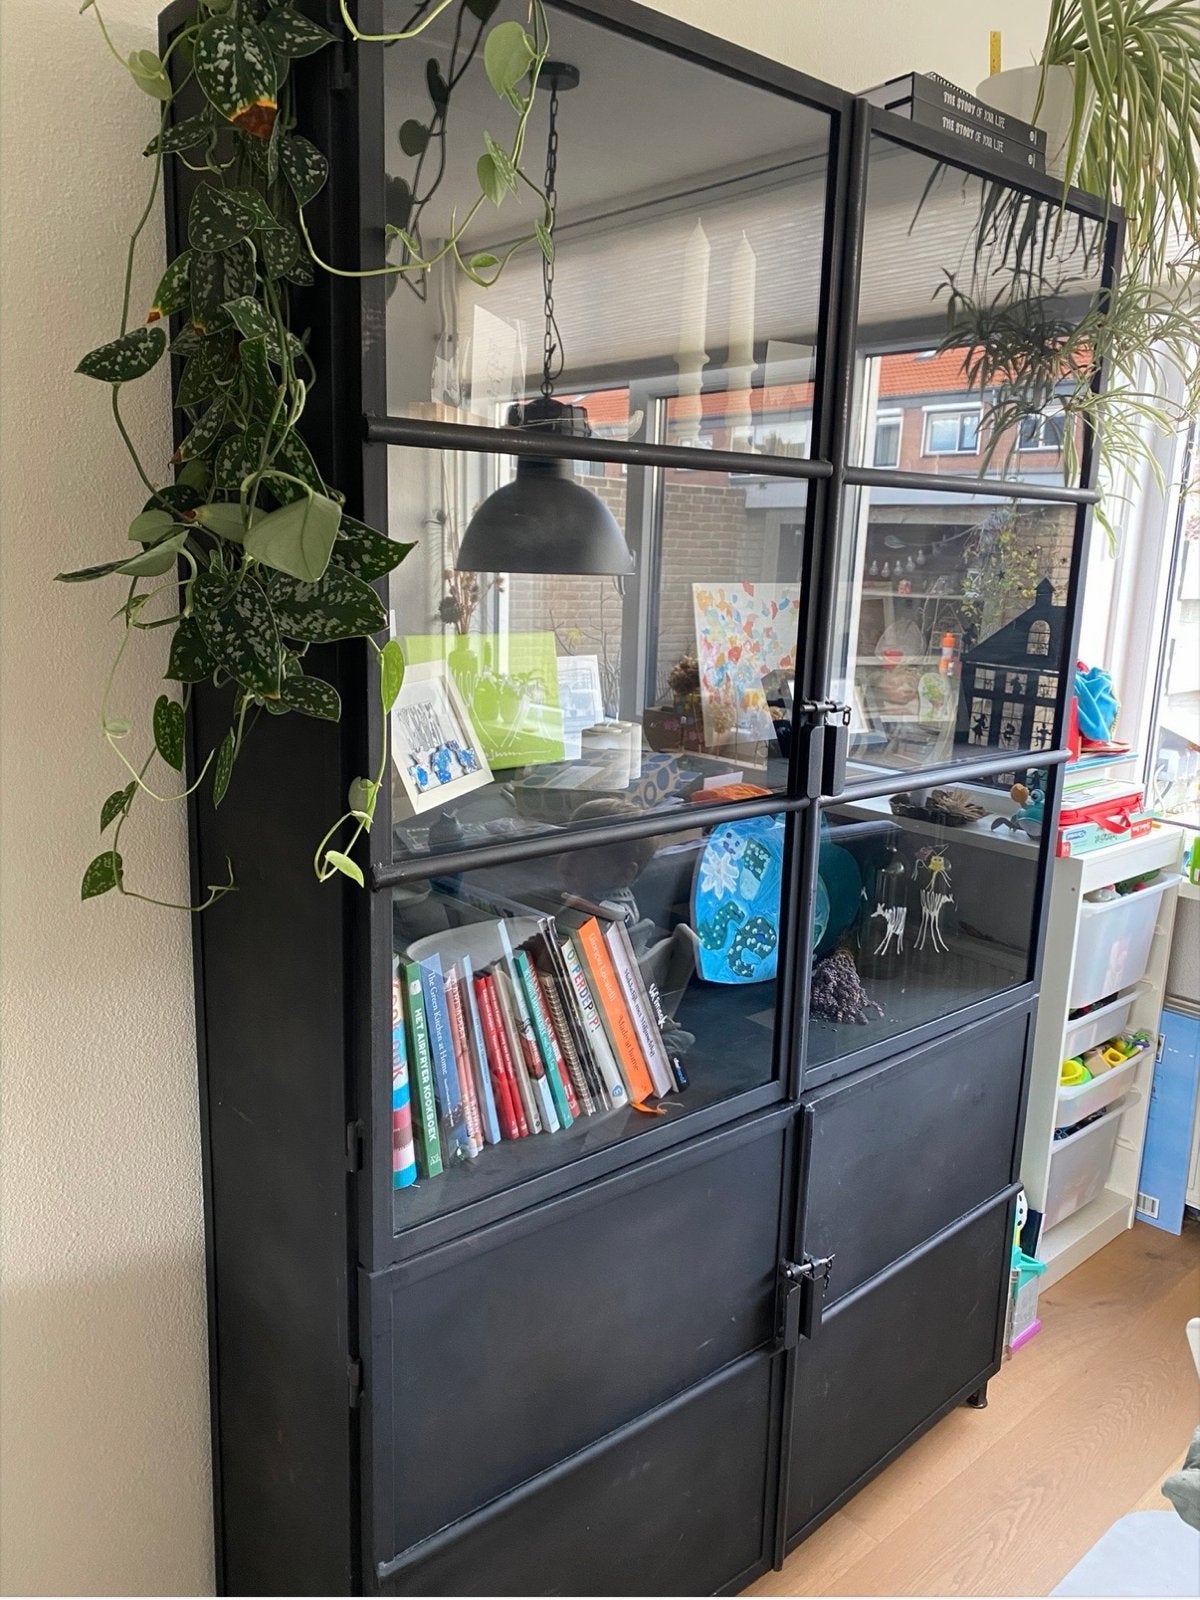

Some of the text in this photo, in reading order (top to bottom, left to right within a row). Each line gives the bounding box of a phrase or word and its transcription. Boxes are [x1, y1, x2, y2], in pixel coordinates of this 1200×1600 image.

[943, 91, 956, 107] THE
[957, 98, 976, 115] STORY
[976, 107, 983, 118] OF
[995, 114, 1006, 130] LIFE
[942, 116, 955, 132] THE
[955, 122, 975, 140] STORY
[975, 131, 982, 143] OF
[993, 138, 1004, 153] LIFE
[430, 986, 439, 1011] Green
[414, 1008, 425, 1030] HET
[434, 1010, 445, 1042] Kitchen
[417, 1033, 430, 1084] AIRFRYER
[439, 1049, 448, 1074] Home
[423, 1086, 437, 1142] KOOKBOEK
